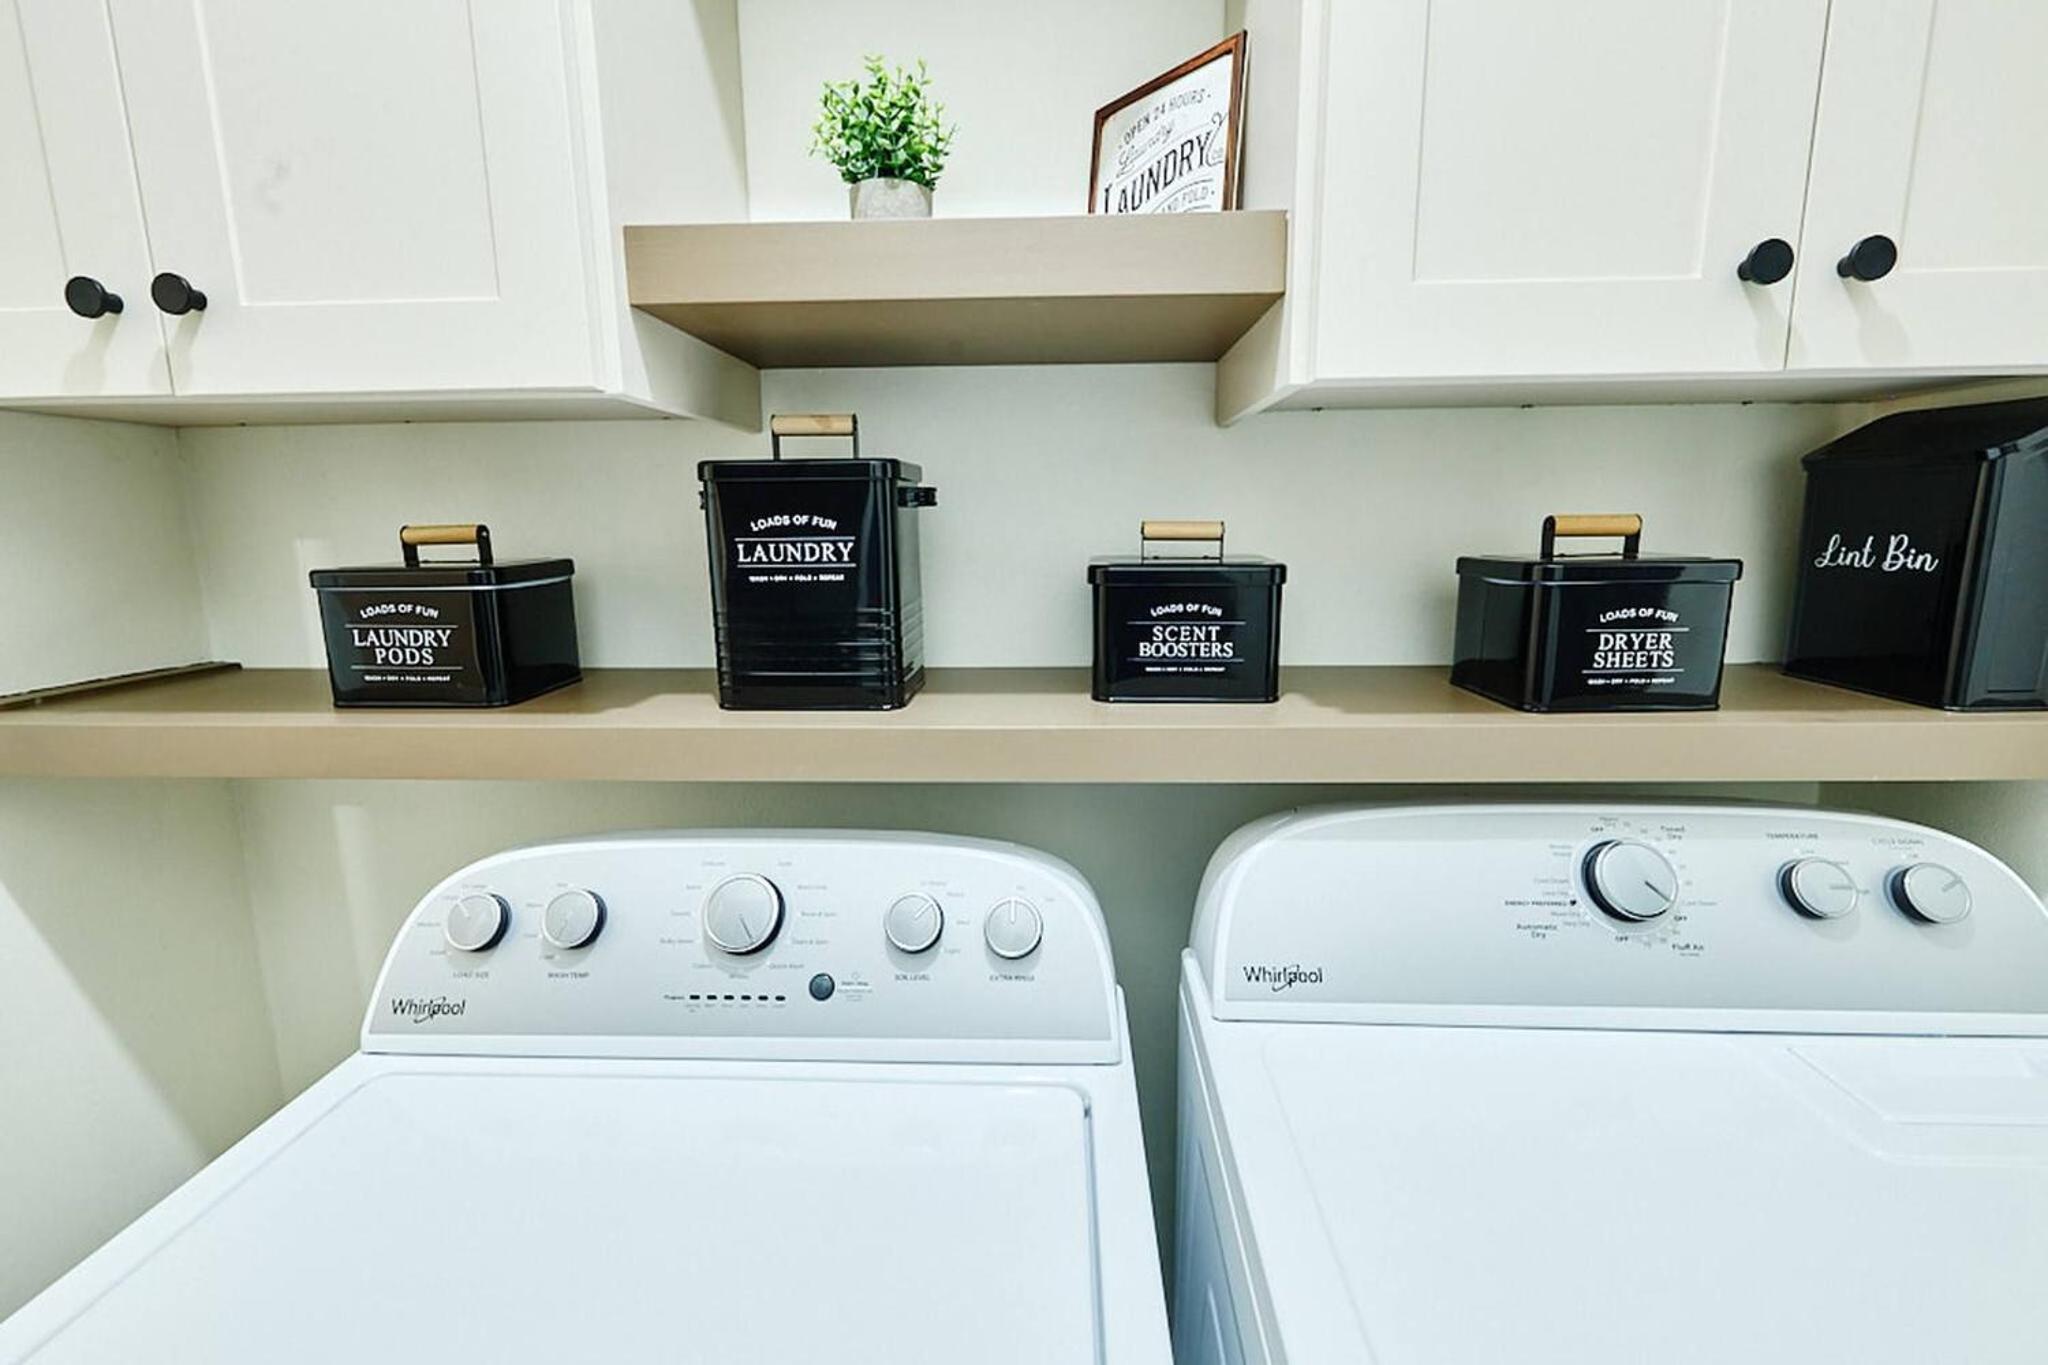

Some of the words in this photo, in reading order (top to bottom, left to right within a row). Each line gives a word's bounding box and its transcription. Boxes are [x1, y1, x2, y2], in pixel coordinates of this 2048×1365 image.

[1124, 113, 1150, 145] OPEN
[1154, 103, 1166, 121] 24
[1168, 88, 1207, 112] HOURS
[1104, 130, 1213, 214] LAUNDRY
[750, 514, 790, 532] LOADS
[792, 514, 809, 526] OF
[811, 515, 837, 531] FUN
[737, 541, 854, 562] LAUNDRY
[1814, 533, 1876, 568] Lint
[1881, 533, 1939, 572] Bin
[360, 604, 396, 619] LOADS
[397, 604, 413, 613] OF
[415, 605, 439, 619] FUN
[1150, 603, 1184, 617] LOADS
[1186, 603, 1200, 612] OF
[1201, 604, 1222, 617] FUN
[1599, 608, 1636, 622] LOADS
[1638, 607, 1654, 617] OF
[1655, 609, 1679, 622] FUN
[352, 629, 451, 647] LAUNDRY
[1152, 625, 1220, 641] SCENT
[1598, 632, 1674, 650] DRYER
[375, 648, 434, 665] PODS
[1139, 642, 1233, 658] BOOSTERS
[1592, 651, 1675, 668] SHEETS
[1243, 964, 1322, 991] Whirlpool
[392, 996, 466, 1024] Whirlpool
